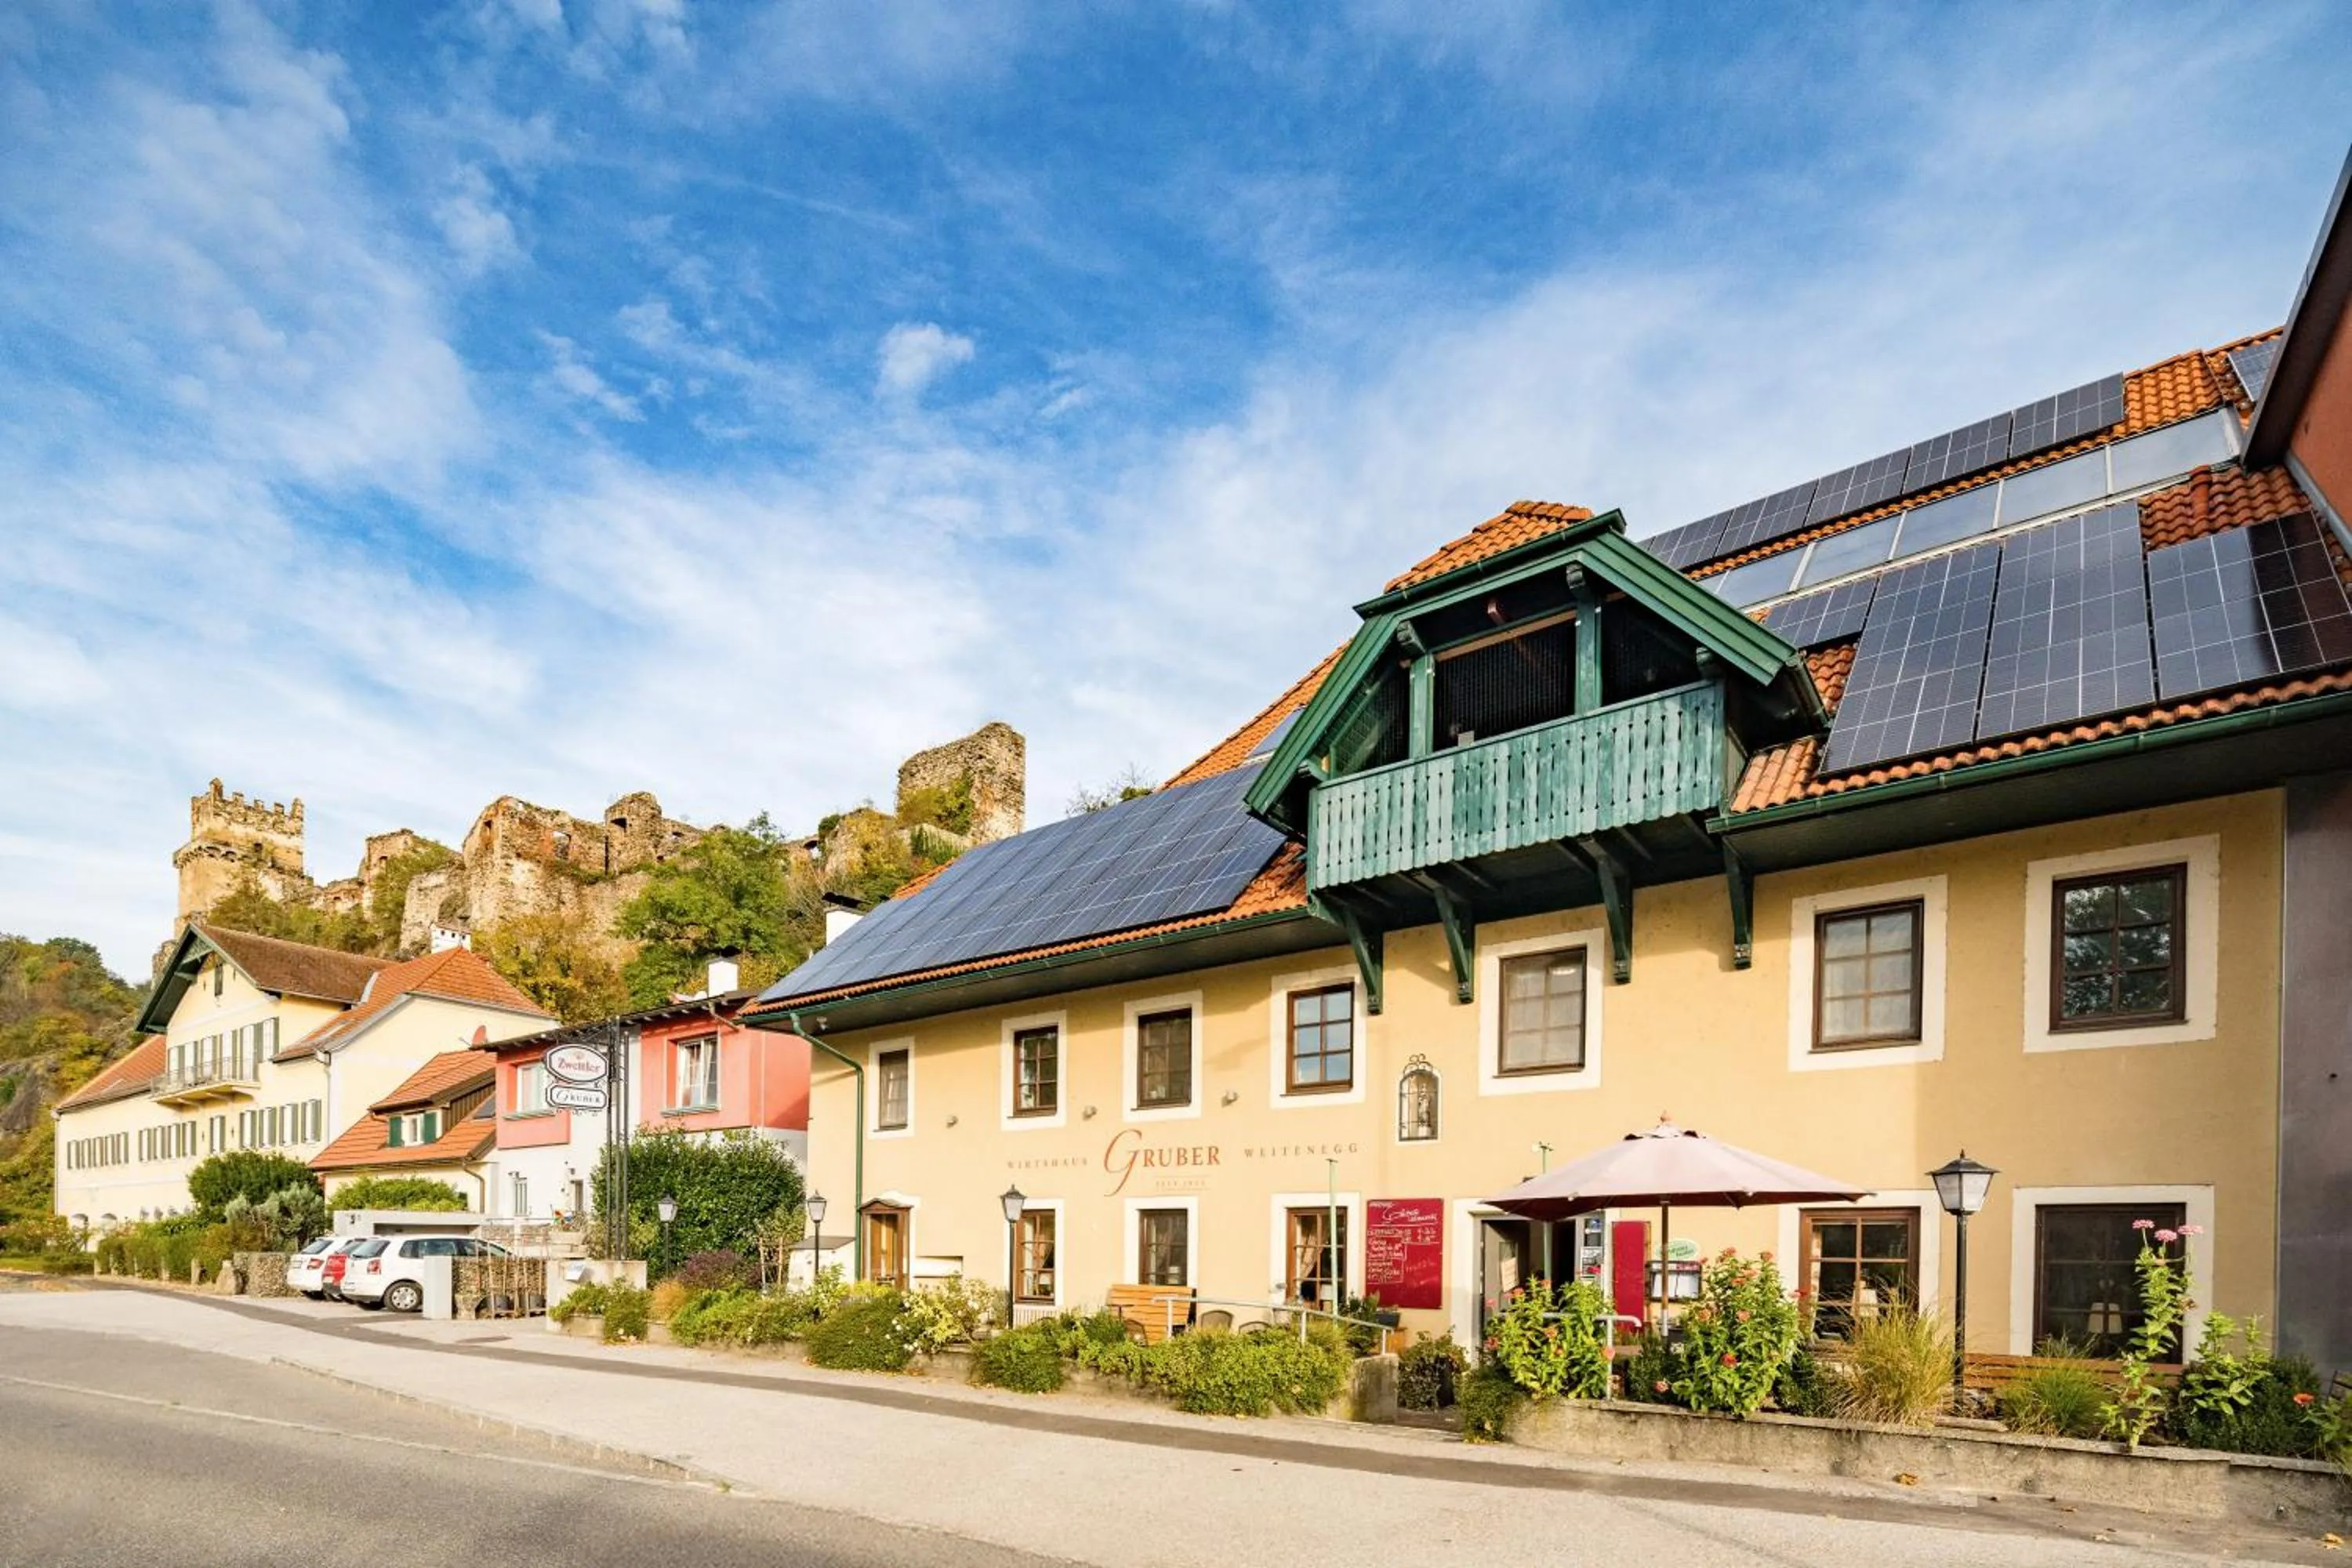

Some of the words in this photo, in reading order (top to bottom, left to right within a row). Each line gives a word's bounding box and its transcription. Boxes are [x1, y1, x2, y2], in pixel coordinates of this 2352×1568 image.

[557, 1058, 601, 1073] Zwettler
[1007, 1157, 1088, 1170] WIRTSHAUS
[1103, 1128, 1221, 1197] GRUBER
[1243, 1142, 1359, 1158] WEITENEGG
